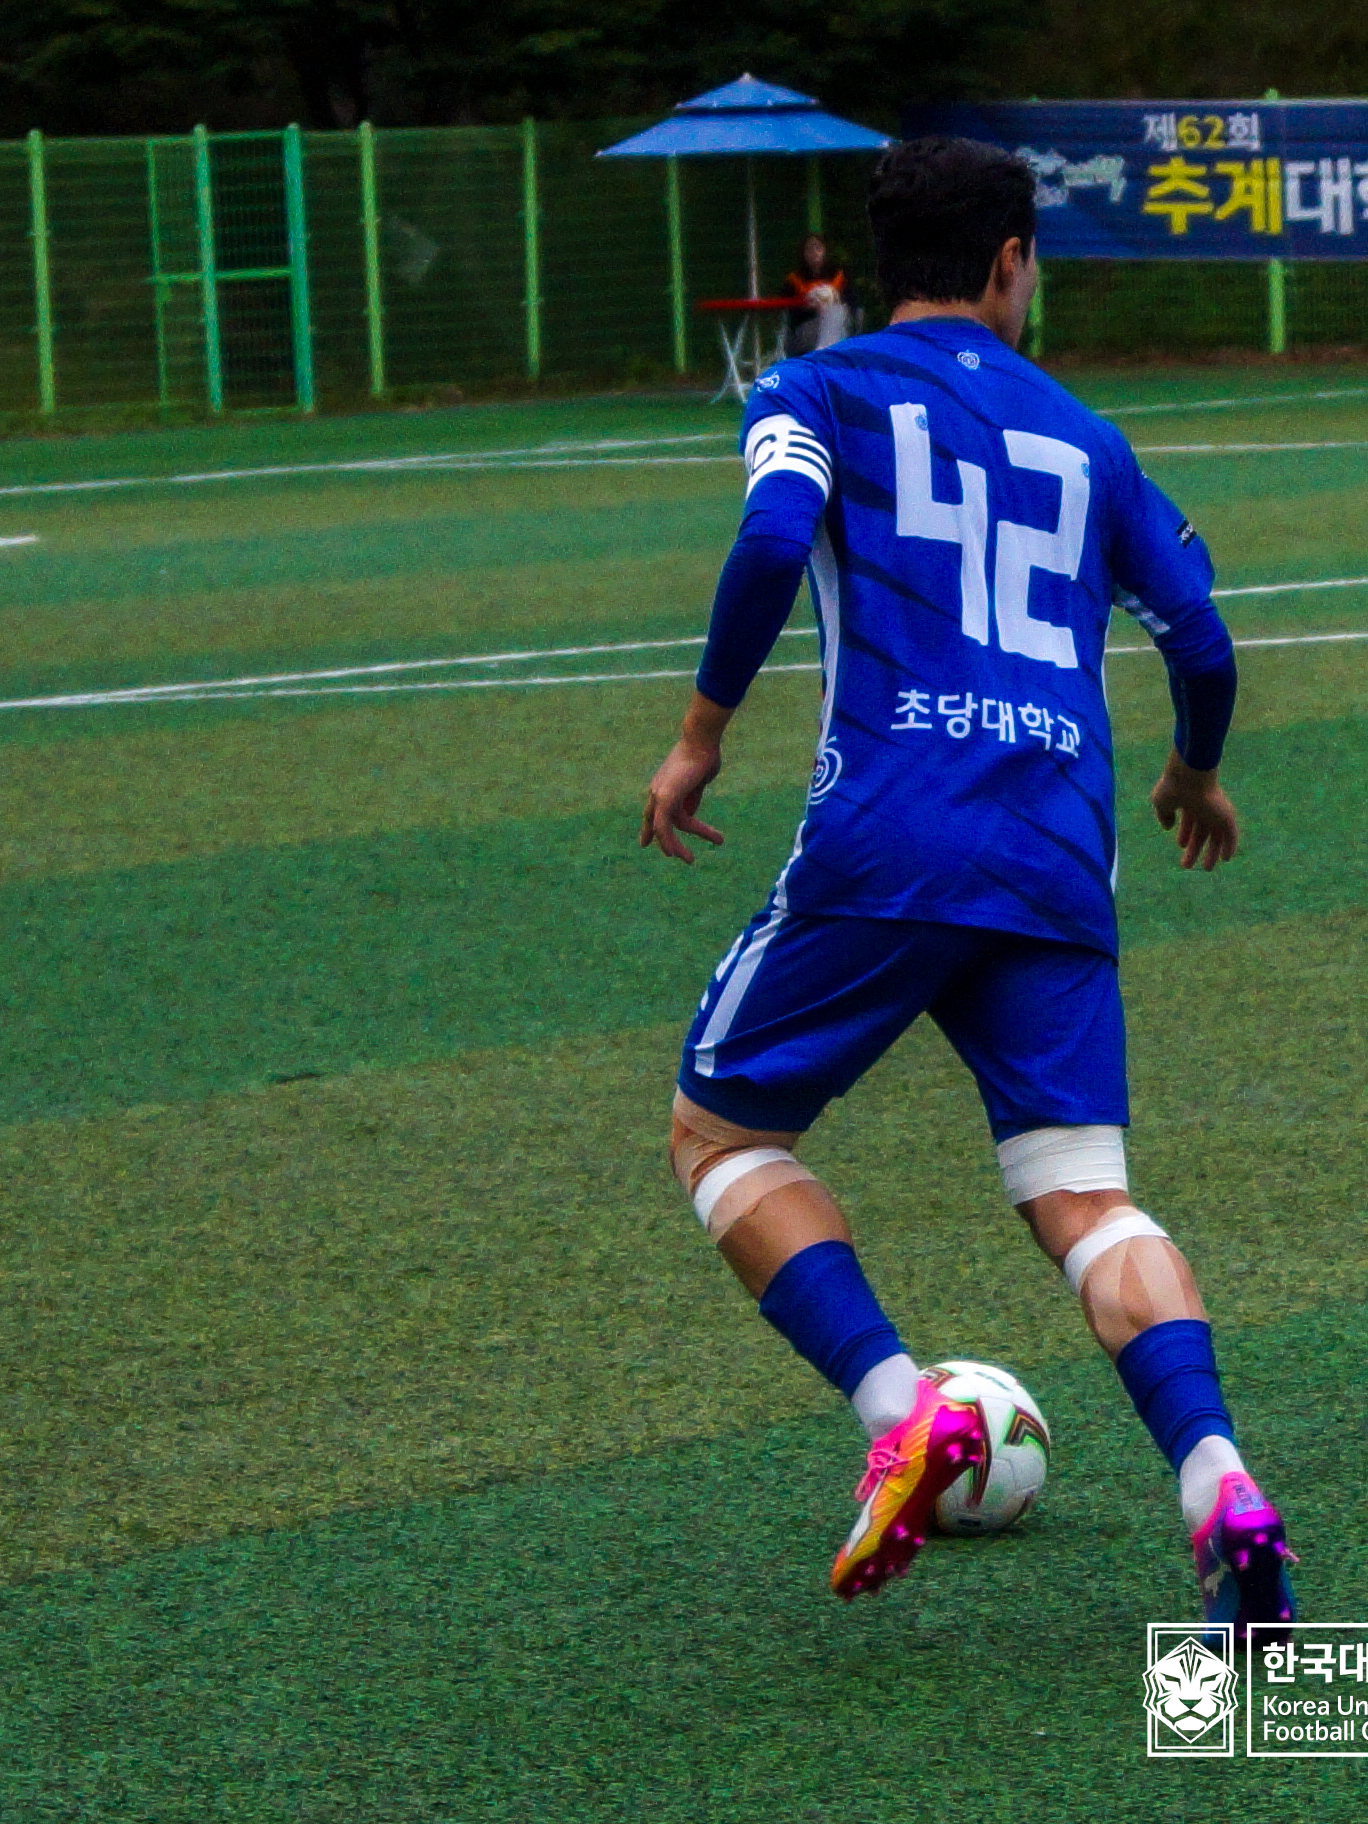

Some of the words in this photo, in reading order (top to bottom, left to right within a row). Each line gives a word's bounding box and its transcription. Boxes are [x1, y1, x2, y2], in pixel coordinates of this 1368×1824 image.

[1143, 111, 1261, 152] 제62회
[888, 401, 1090, 669] 42
[890, 689, 1081, 759] 초당대학교
